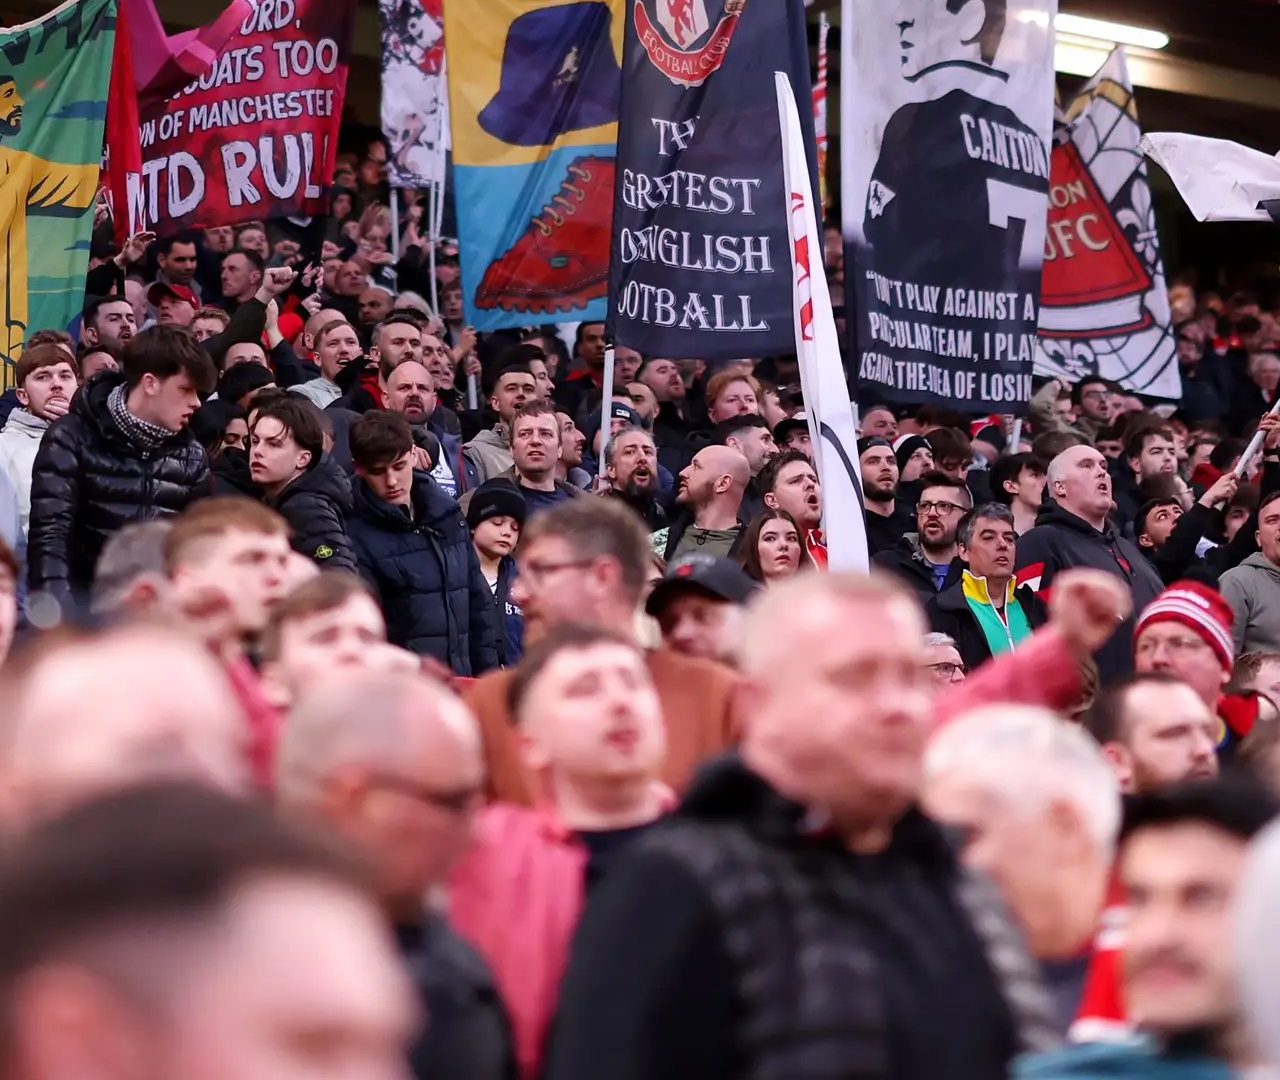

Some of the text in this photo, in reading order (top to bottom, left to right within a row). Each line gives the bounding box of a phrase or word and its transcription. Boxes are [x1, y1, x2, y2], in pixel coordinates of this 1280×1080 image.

[273, 37, 338, 78] TOO
[642, 30, 699, 75] FOOTBALL
[159, 114, 183, 141] OF
[651, 115, 700, 157] TH
[960, 113, 1048, 181] CANTON
[221, 131, 328, 208] RUL
[986, 178, 1048, 270] 7
[618, 280, 771, 331] OTBALL
[905, 283, 941, 314] PLAY
[943, 287, 1018, 321] AGAINST
[1023, 293, 1035, 321] A
[932, 326, 979, 363] TEAM,
[983, 332, 991, 360] I
[994, 333, 1037, 363] PLAY
[895, 361, 928, 391] THE
[954, 370, 977, 400] OF
[981, 372, 1032, 402] LOSIN
